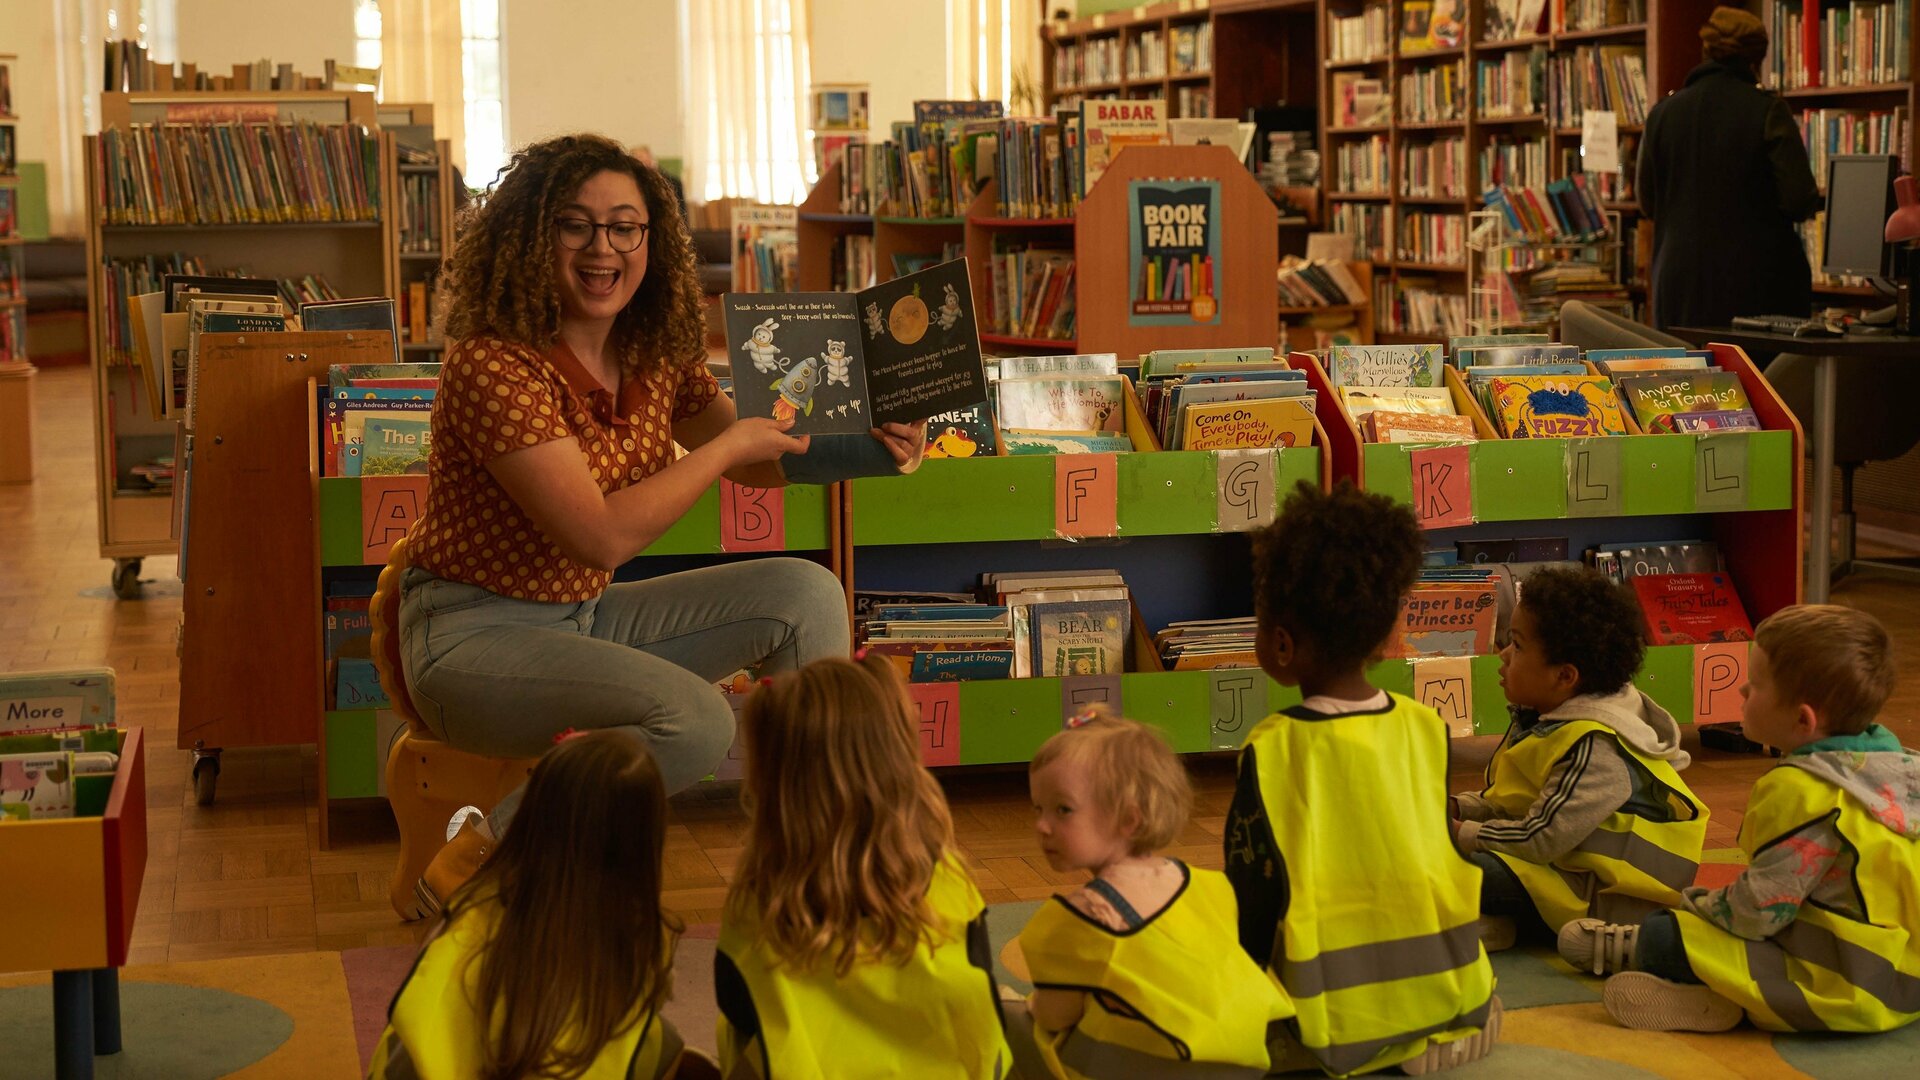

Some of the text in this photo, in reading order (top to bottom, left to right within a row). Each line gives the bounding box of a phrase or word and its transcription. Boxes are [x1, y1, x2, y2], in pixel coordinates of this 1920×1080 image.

[1098, 105, 1156, 120] BABAR
[1143, 204, 1206, 225] BOOK
[1147, 225, 1204, 247] FAIR
[237, 319, 281, 327] LONDON'S
[901, 359, 913, 369] never
[914, 357, 925, 365] been
[947, 346, 958, 354] have
[958, 343, 967, 351] her
[1361, 349, 1408, 366] Millie's
[1523, 354, 1575, 366] Little Bear
[898, 369, 914, 378] friends
[914, 366, 925, 374] come
[932, 361, 943, 371] play
[963, 371, 971, 379] joy
[1009, 362, 1057, 373] ICHAEL
[1362, 366, 1407, 376] Marvellous
[1048, 387, 1104, 400] Where To,
[1637, 381, 1691, 402] Anyone
[1653, 388, 1737, 410] for Tennis?
[837, 403, 848, 417] up
[850, 399, 861, 414] up
[1070, 398, 1119, 411] Wombat?
[825, 409, 834, 420] up
[1195, 410, 1252, 427] Come On
[1533, 417, 1600, 436] FUZZY
[382, 429, 416, 445] The
[1192, 437, 1224, 451] Time
[1236, 429, 1274, 446] Play!
[1576, 450, 1608, 502] L
[1703, 447, 1739, 493] L
[1066, 467, 1097, 524] F
[1224, 460, 1259, 520] G
[1421, 462, 1453, 520] K
[367, 489, 419, 548] A
[732, 482, 772, 541] B
[1634, 561, 1676, 577] On A
[1666, 584, 1697, 592] Treasury
[1669, 577, 1696, 585] Oxford
[1399, 597, 1483, 615] Paper Bag
[1655, 588, 1729, 612] Fairy Tales
[1058, 619, 1104, 634] BEAR
[1406, 613, 1475, 626] Princess
[1058, 638, 1081, 646] SCARY
[936, 653, 1007, 666] Read at Home
[939, 672, 957, 680] The
[1699, 653, 1740, 716] P
[1215, 676, 1254, 733] J
[1423, 677, 1467, 719] M
[7, 701, 65, 721] More
